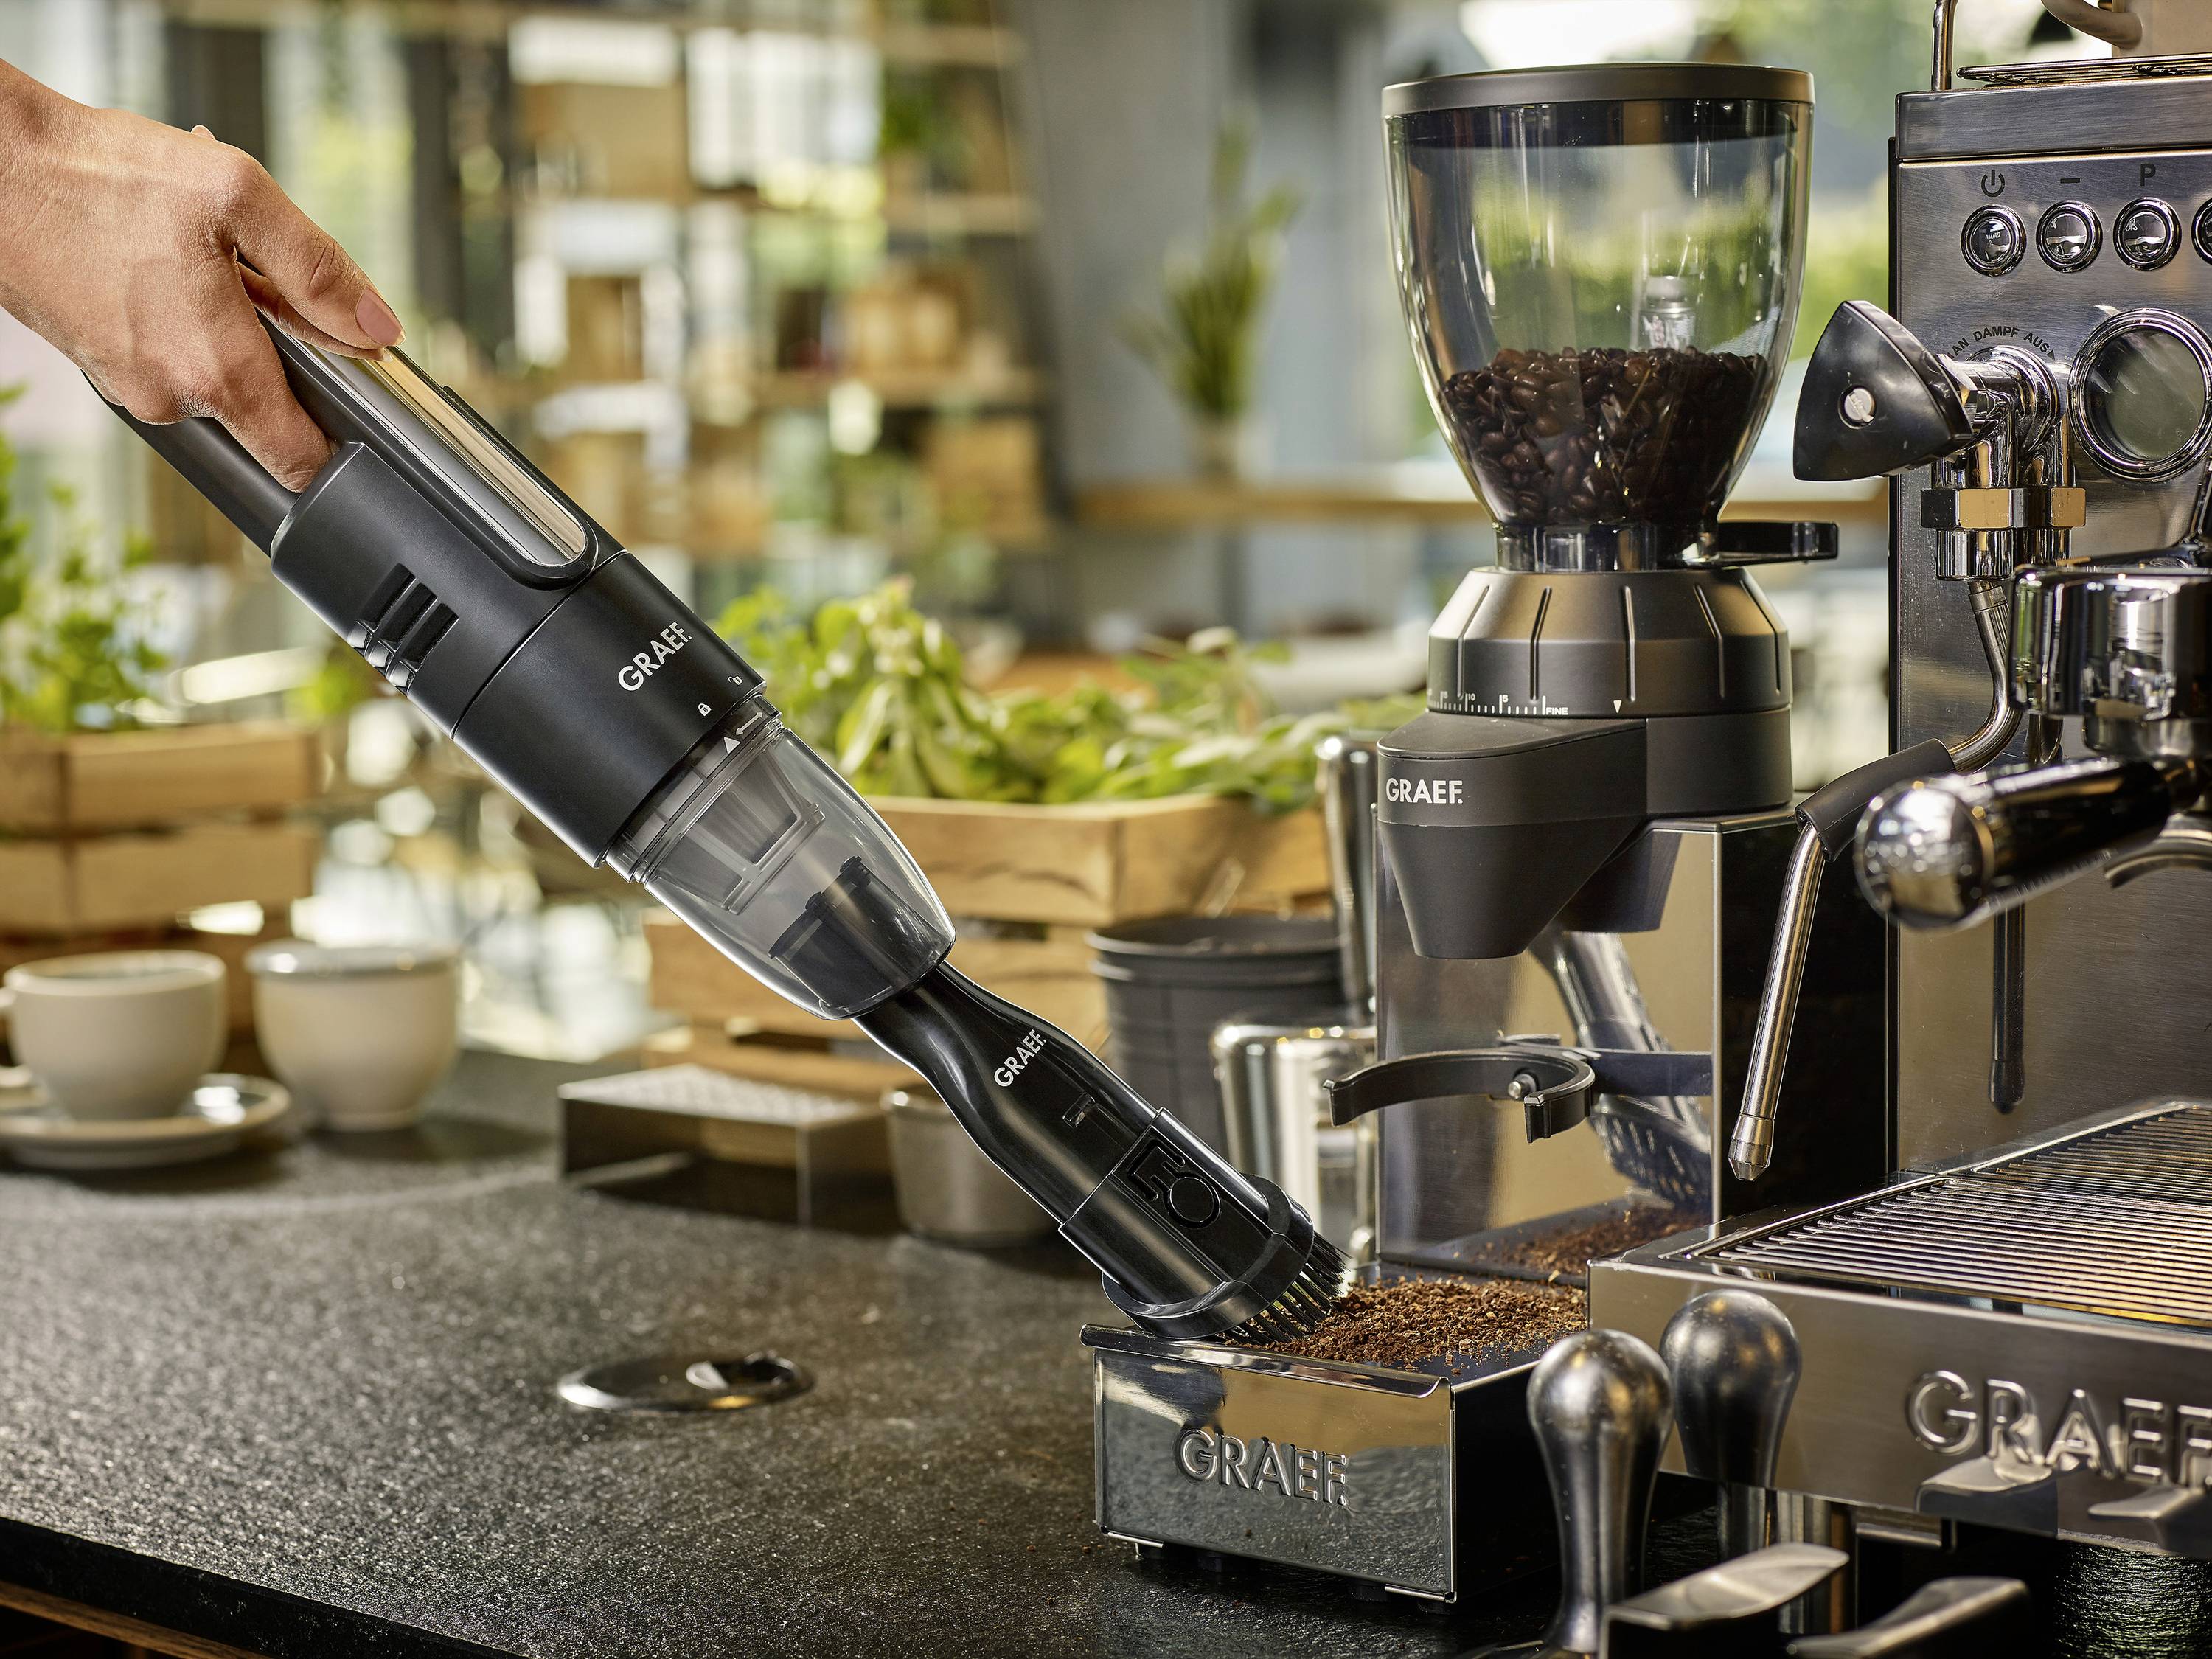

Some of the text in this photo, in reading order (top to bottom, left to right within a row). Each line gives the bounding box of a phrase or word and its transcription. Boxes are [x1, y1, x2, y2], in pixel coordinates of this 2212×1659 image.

[2140, 163, 2157, 187] P
[1952, 326, 2050, 356] AN DAMPF AUS
[1545, 707, 1569, 715] FINE
